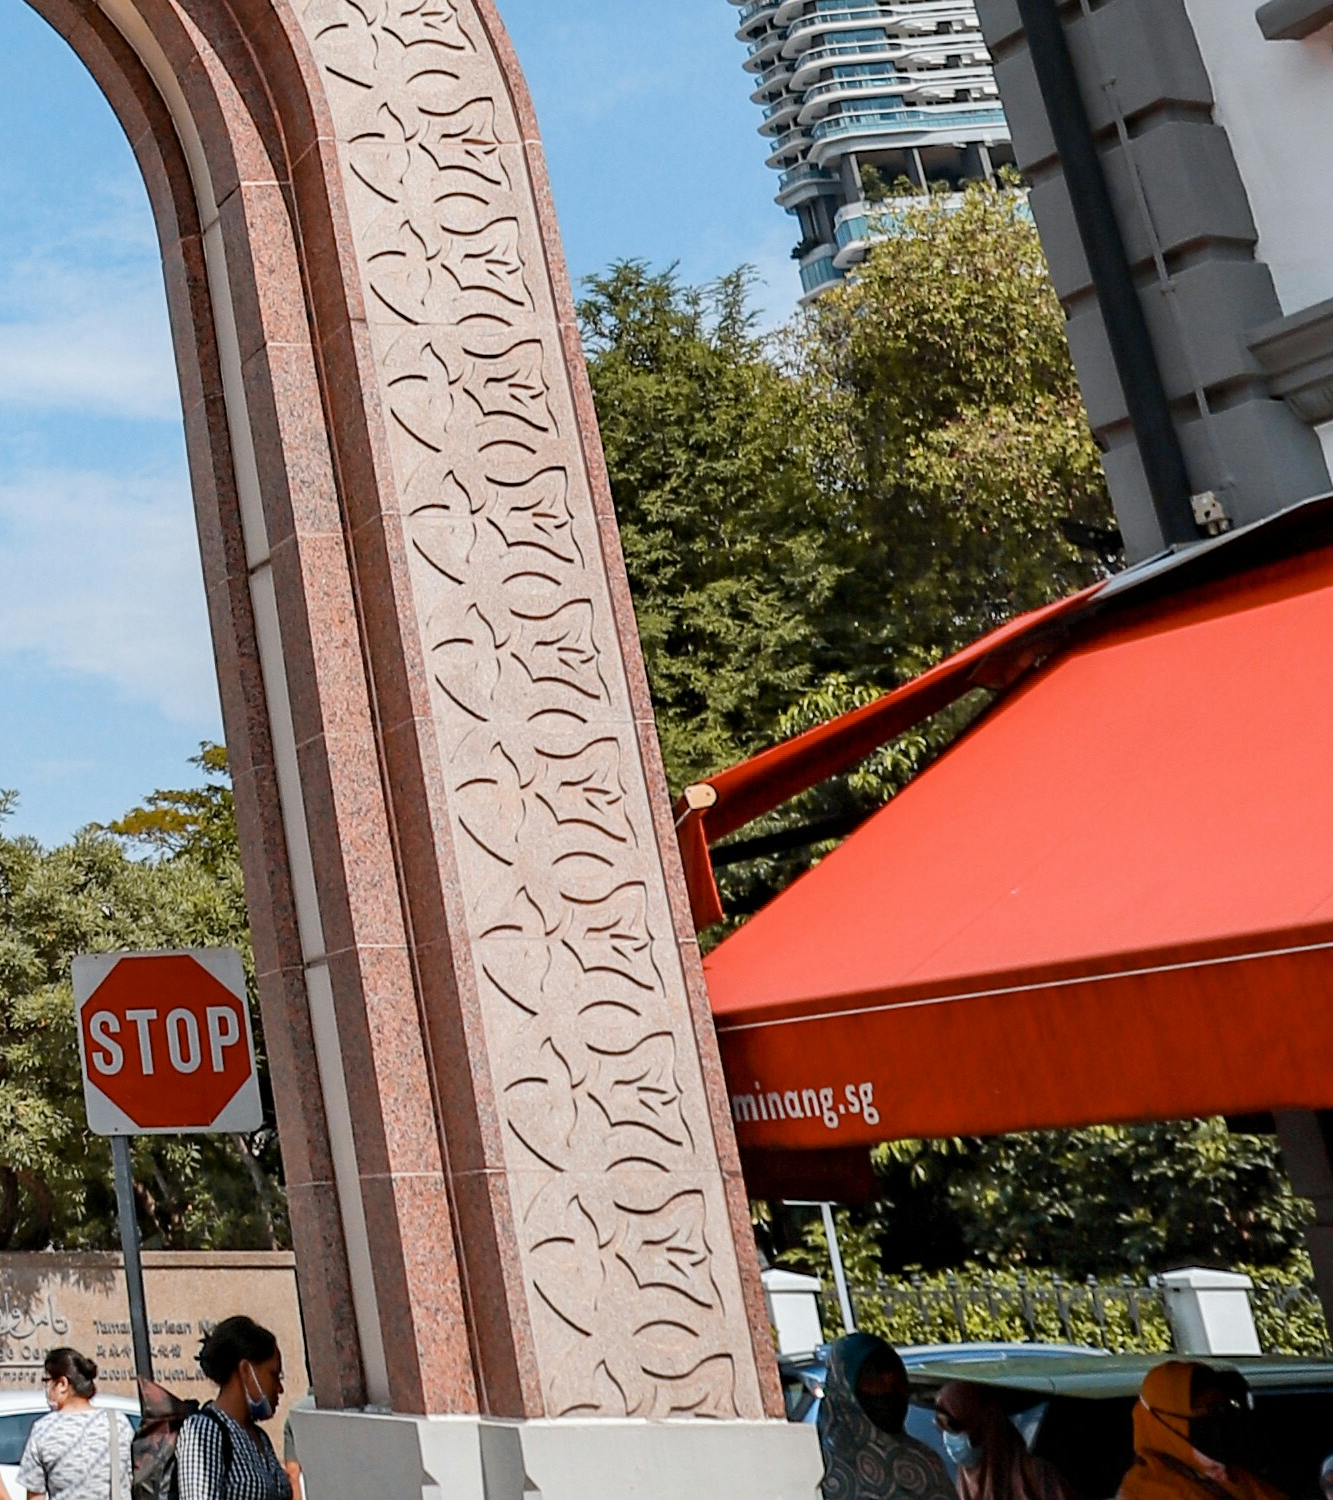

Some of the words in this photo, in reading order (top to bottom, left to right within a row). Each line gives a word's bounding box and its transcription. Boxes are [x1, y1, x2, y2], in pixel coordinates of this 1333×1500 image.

[89, 1006, 240, 1076] STOP
[733, 1081, 880, 1129] minang.sg
[93, 1319, 131, 1335] Tama
[149, 1319, 192, 1335] arisan
